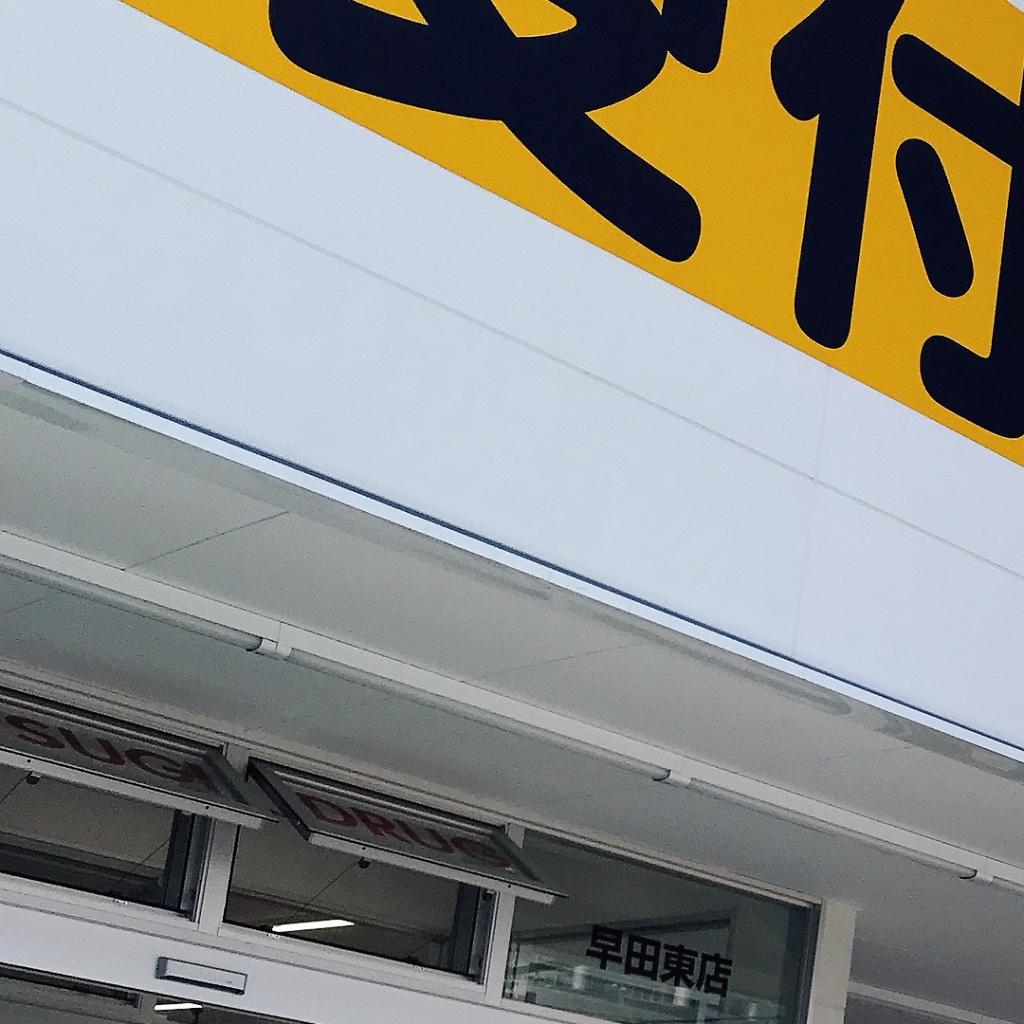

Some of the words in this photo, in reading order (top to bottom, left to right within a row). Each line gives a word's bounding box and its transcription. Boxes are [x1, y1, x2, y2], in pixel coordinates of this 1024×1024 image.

[295, 791, 513, 868] DRUG
[586, 924, 733, 998] 早田東店
